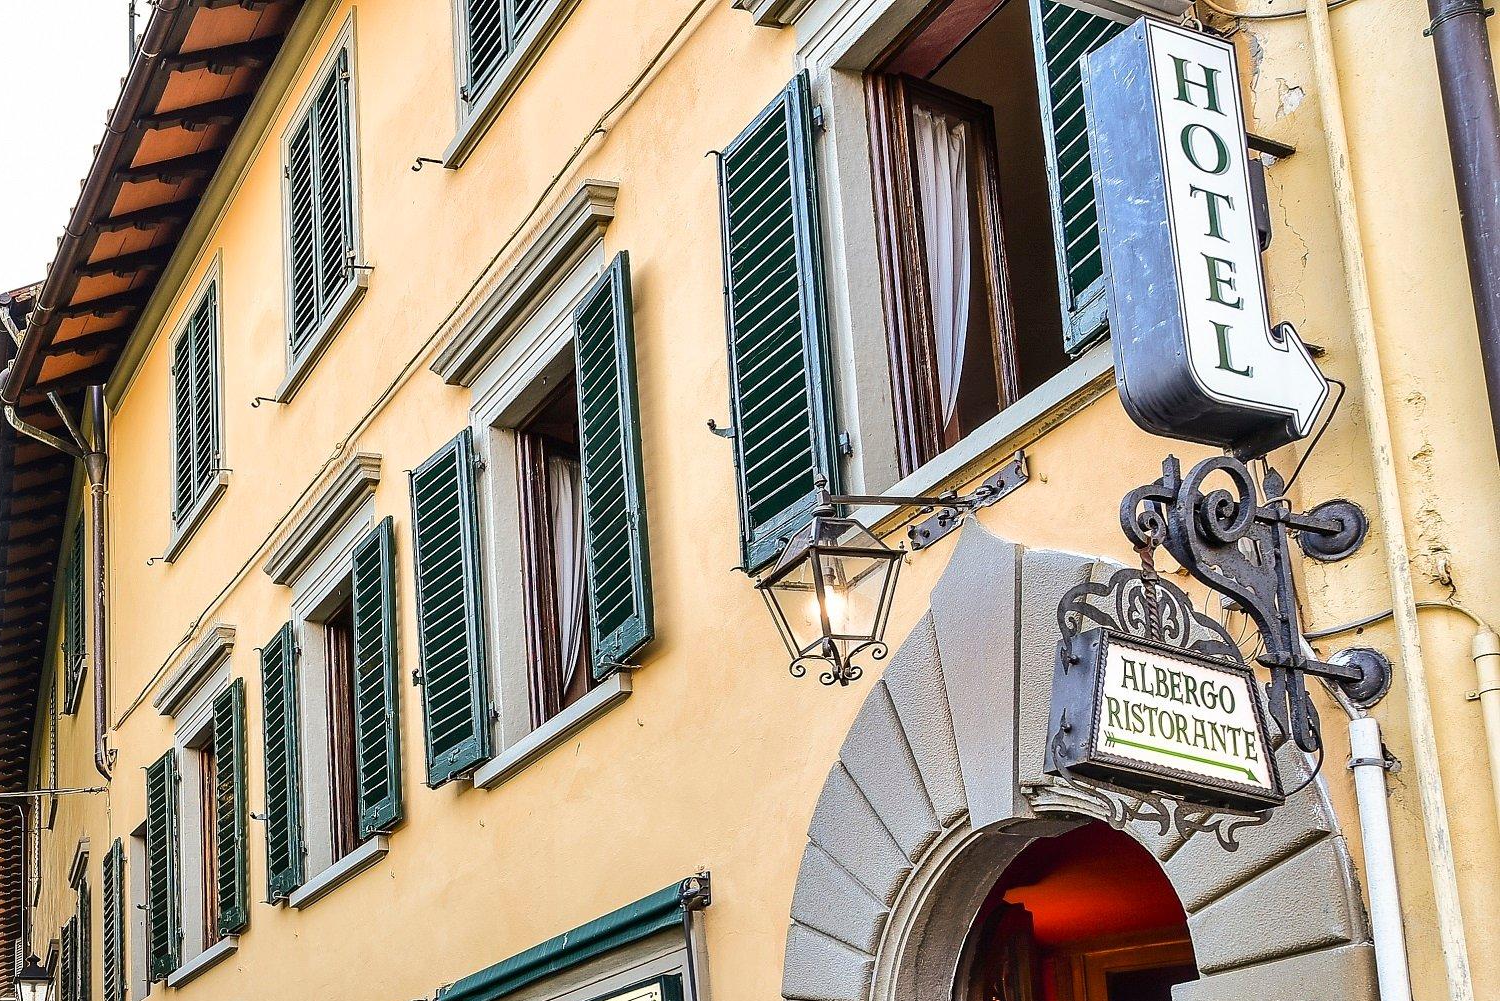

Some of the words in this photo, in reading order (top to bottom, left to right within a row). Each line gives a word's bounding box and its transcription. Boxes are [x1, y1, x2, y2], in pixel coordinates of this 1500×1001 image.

[1167, 54, 1254, 378] HOTEL
[1120, 655, 1236, 714] ALBERGO
[1105, 696, 1259, 762] RISTORANTE
